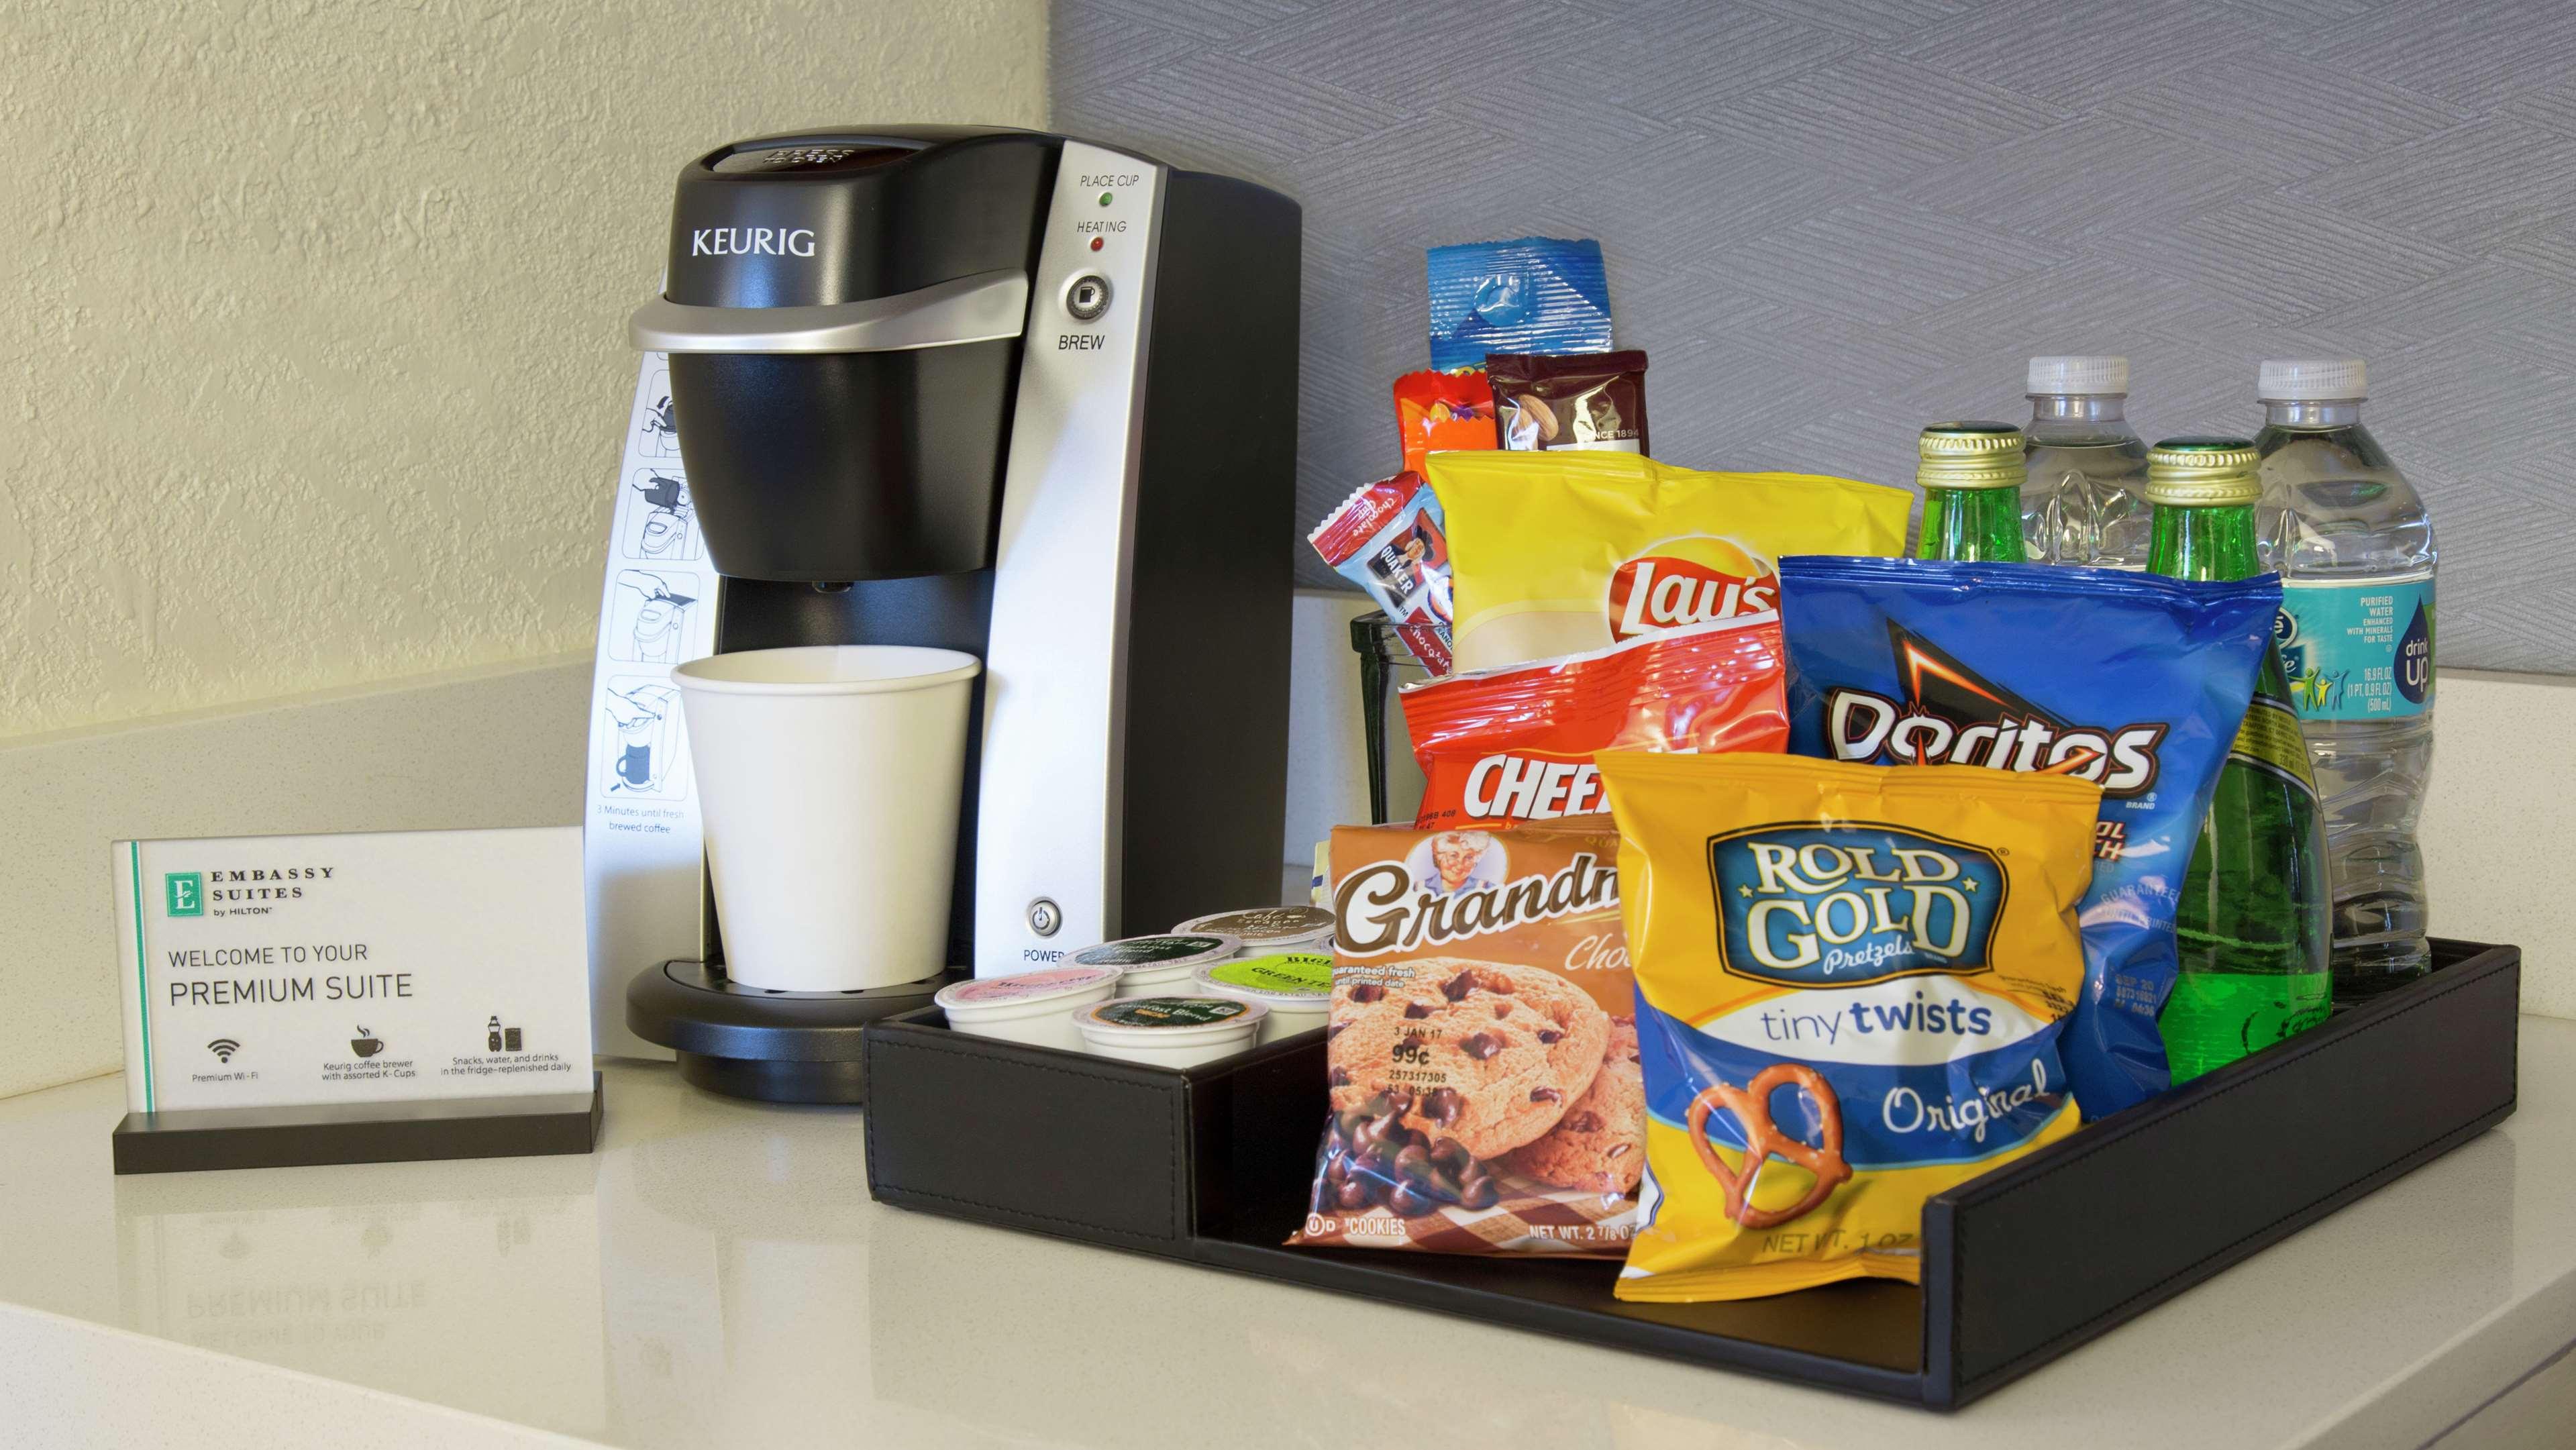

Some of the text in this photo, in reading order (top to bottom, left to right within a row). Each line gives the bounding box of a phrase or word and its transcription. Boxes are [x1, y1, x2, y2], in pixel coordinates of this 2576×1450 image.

[1080, 174, 1140, 187] PLACE CUP
[1076, 221, 1127, 233] HEATING
[692, 227, 815, 257] KEURIG
[1058, 334, 1105, 350] BREW
[1616, 429, 1639, 438] 1894
[1380, 546, 1414, 594] QUAKER
[1620, 562, 1775, 634] Lay's
[2361, 595, 2393, 607] PURIFIED
[2369, 607, 2393, 617] WATER
[2363, 617, 2393, 626] ENHANCED
[2347, 625, 2393, 635] WITH MINERALS
[2364, 634, 2393, 643] FOR TASTE
[2406, 638, 2428, 657] drink
[1833, 689, 2159, 789] Doritos
[1463, 754, 1612, 820] CHEE
[604, 805, 639, 817] Minutes
[641, 809, 661, 818] until
[663, 809, 684, 819] fresh
[2125, 800, 2156, 810] BRAND
[609, 821, 670, 833] brewed coffee
[2096, 821, 2126, 839] OL
[210, 867, 333, 882] EMBASSY
[1747, 841, 1959, 894] ROLD
[212, 887, 303, 902] SUITES
[213, 907, 269, 918] by HILTON
[1747, 884, 1971, 970] GOLD
[168, 943, 368, 968] WELCOME TO YOUR
[1823, 934, 1914, 975] Pretzels
[1251, 967, 1333, 988] GREEN TE
[1388, 966, 1416, 978] fresh
[170, 974, 413, 1006] PREMIUM SUITE
[1351, 977, 1383, 987] printed
[1384, 980, 1405, 988] date
[1761, 1007, 1843, 1045] tiny
[1849, 991, 1993, 1037] twists
[1394, 1027, 1443, 1039] 3 JAN 17
[323, 1059, 413, 1072] Keurig coffee brewer
[452, 1053, 559, 1066] Snacks, water, and drinks
[322, 1072, 342, 1081] with
[343, 1070, 380, 1080] assorted
[440, 1067, 449, 1076] in
[451, 1066, 466, 1075] the
[550, 1061, 572, 1072] daily
[192, 1073, 233, 1083] Premium
[1883, 1057, 2051, 1143] Original
[1349, 1217, 1406, 1236] COOKIES
[1529, 1225, 1555, 1239] NET
[1557, 1225, 1584, 1240] WT.
[1586, 1227, 1596, 1240] 2
[1762, 1233, 1810, 1253] NET
[1859, 1232, 1871, 1249] 1
